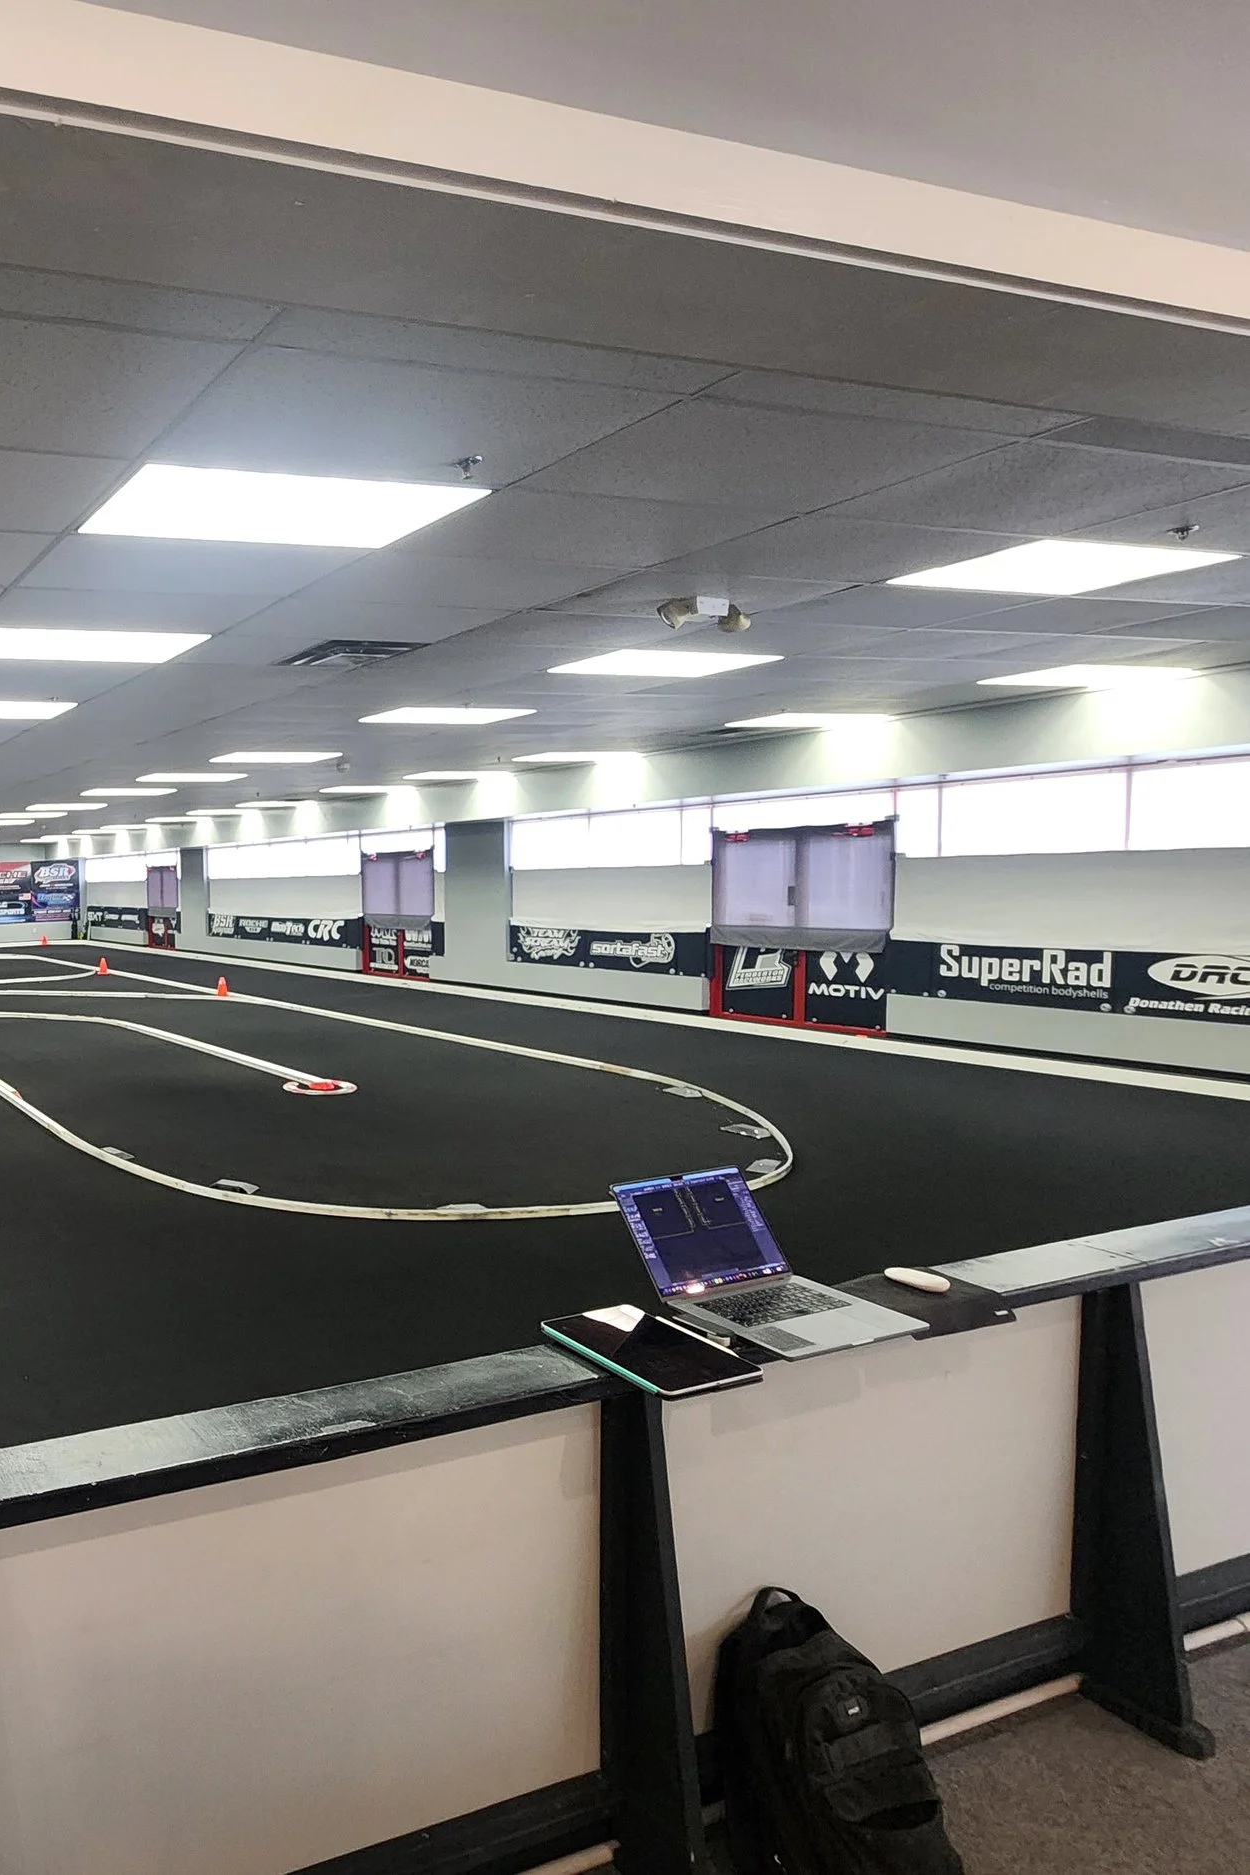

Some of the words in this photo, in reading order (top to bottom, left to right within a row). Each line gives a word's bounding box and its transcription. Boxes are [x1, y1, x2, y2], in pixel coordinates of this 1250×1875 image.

[238, 918, 268, 928] ROCHE
[307, 919, 345, 941] CRC
[531, 928, 565, 938] TEAM
[524, 937, 569, 948] SCREAM
[591, 942, 664, 958] sortafast
[940, 944, 1112, 988] SuperRad
[1169, 963, 1250, 986] DRC
[808, 982, 885, 1001] MOTIV
[988, 983, 1050, 995] competition
[1051, 987, 1109, 999] bodyshells
[1128, 997, 1205, 1012] Donathen
